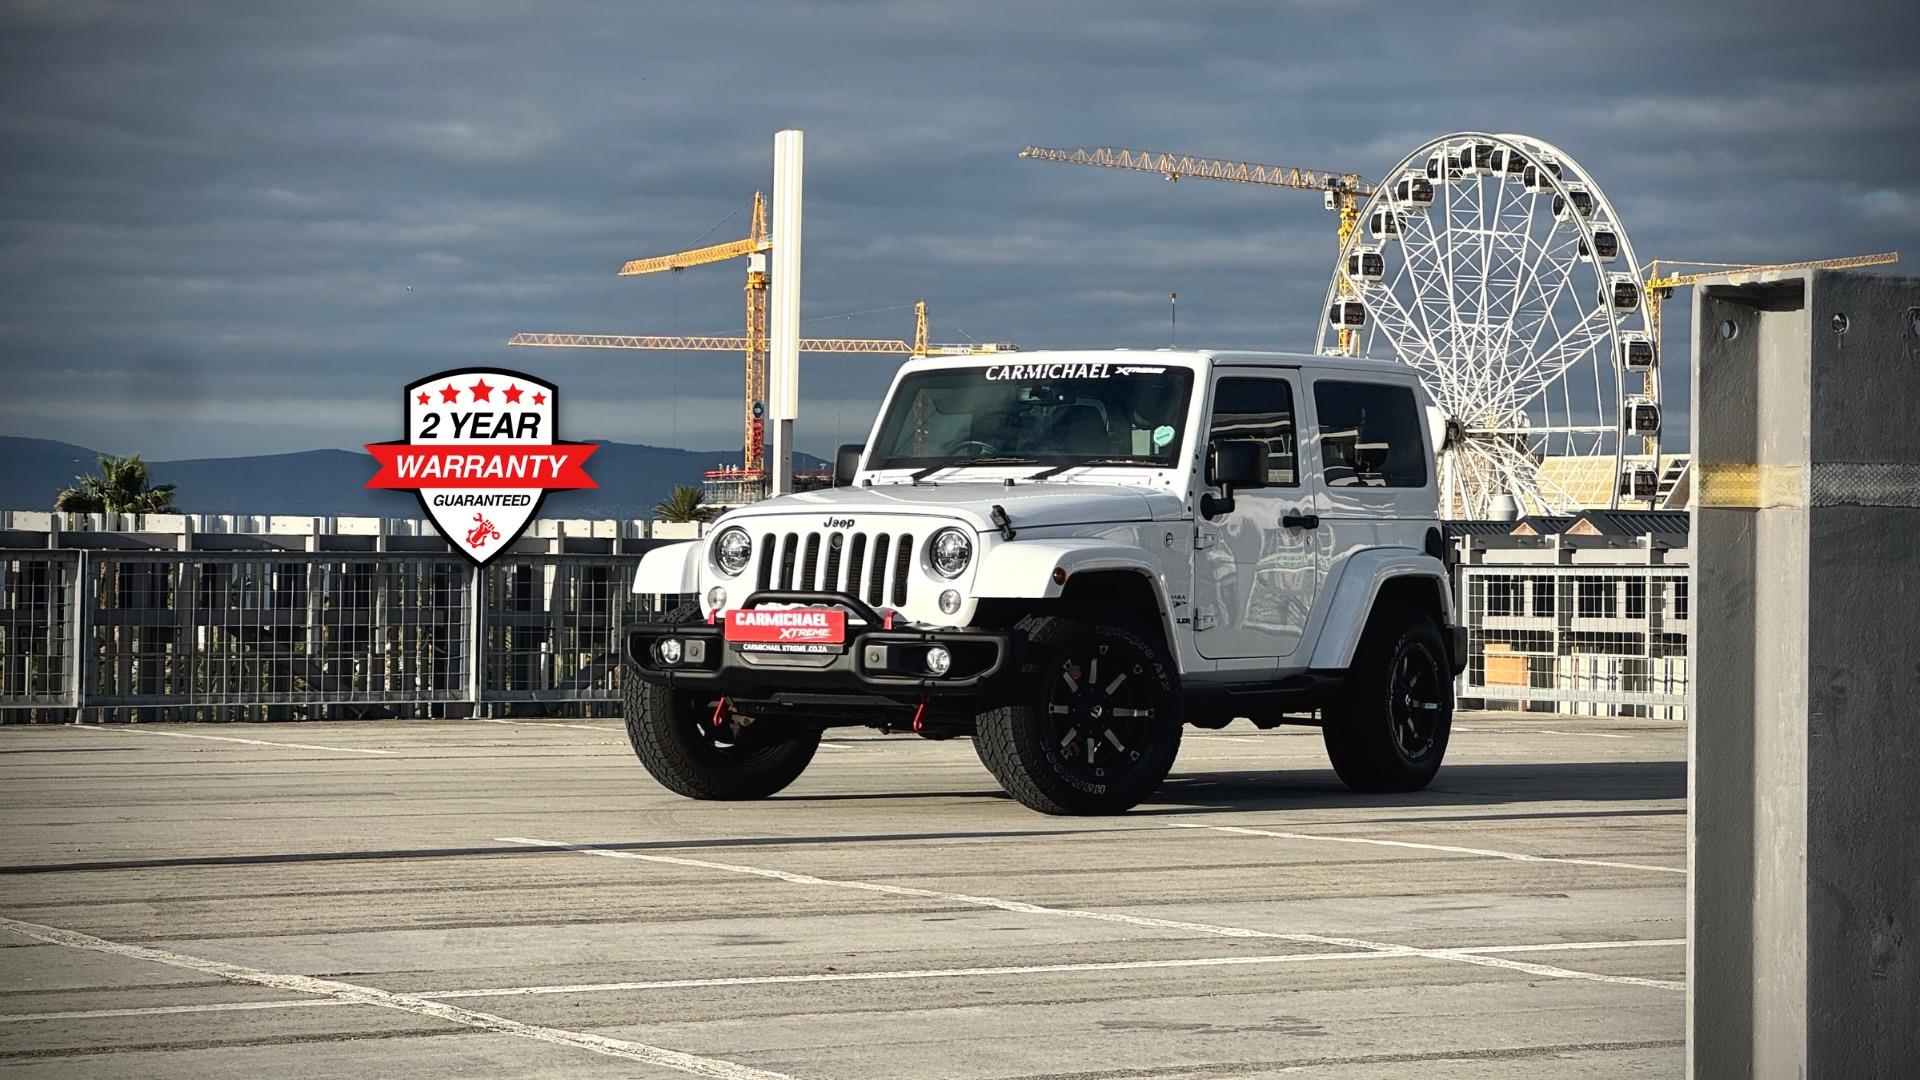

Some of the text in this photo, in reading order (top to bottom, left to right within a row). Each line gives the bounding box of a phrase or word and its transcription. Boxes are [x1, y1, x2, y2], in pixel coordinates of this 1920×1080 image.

[985, 364, 1111, 381] CARMICHAEL
[823, 516, 855, 530] Jeep
[735, 612, 829, 626] CARMICHAEL
[778, 627, 832, 640] XTREME
[742, 643, 781, 652] CARMICHAEL
[782, 644, 807, 652] XTREME
